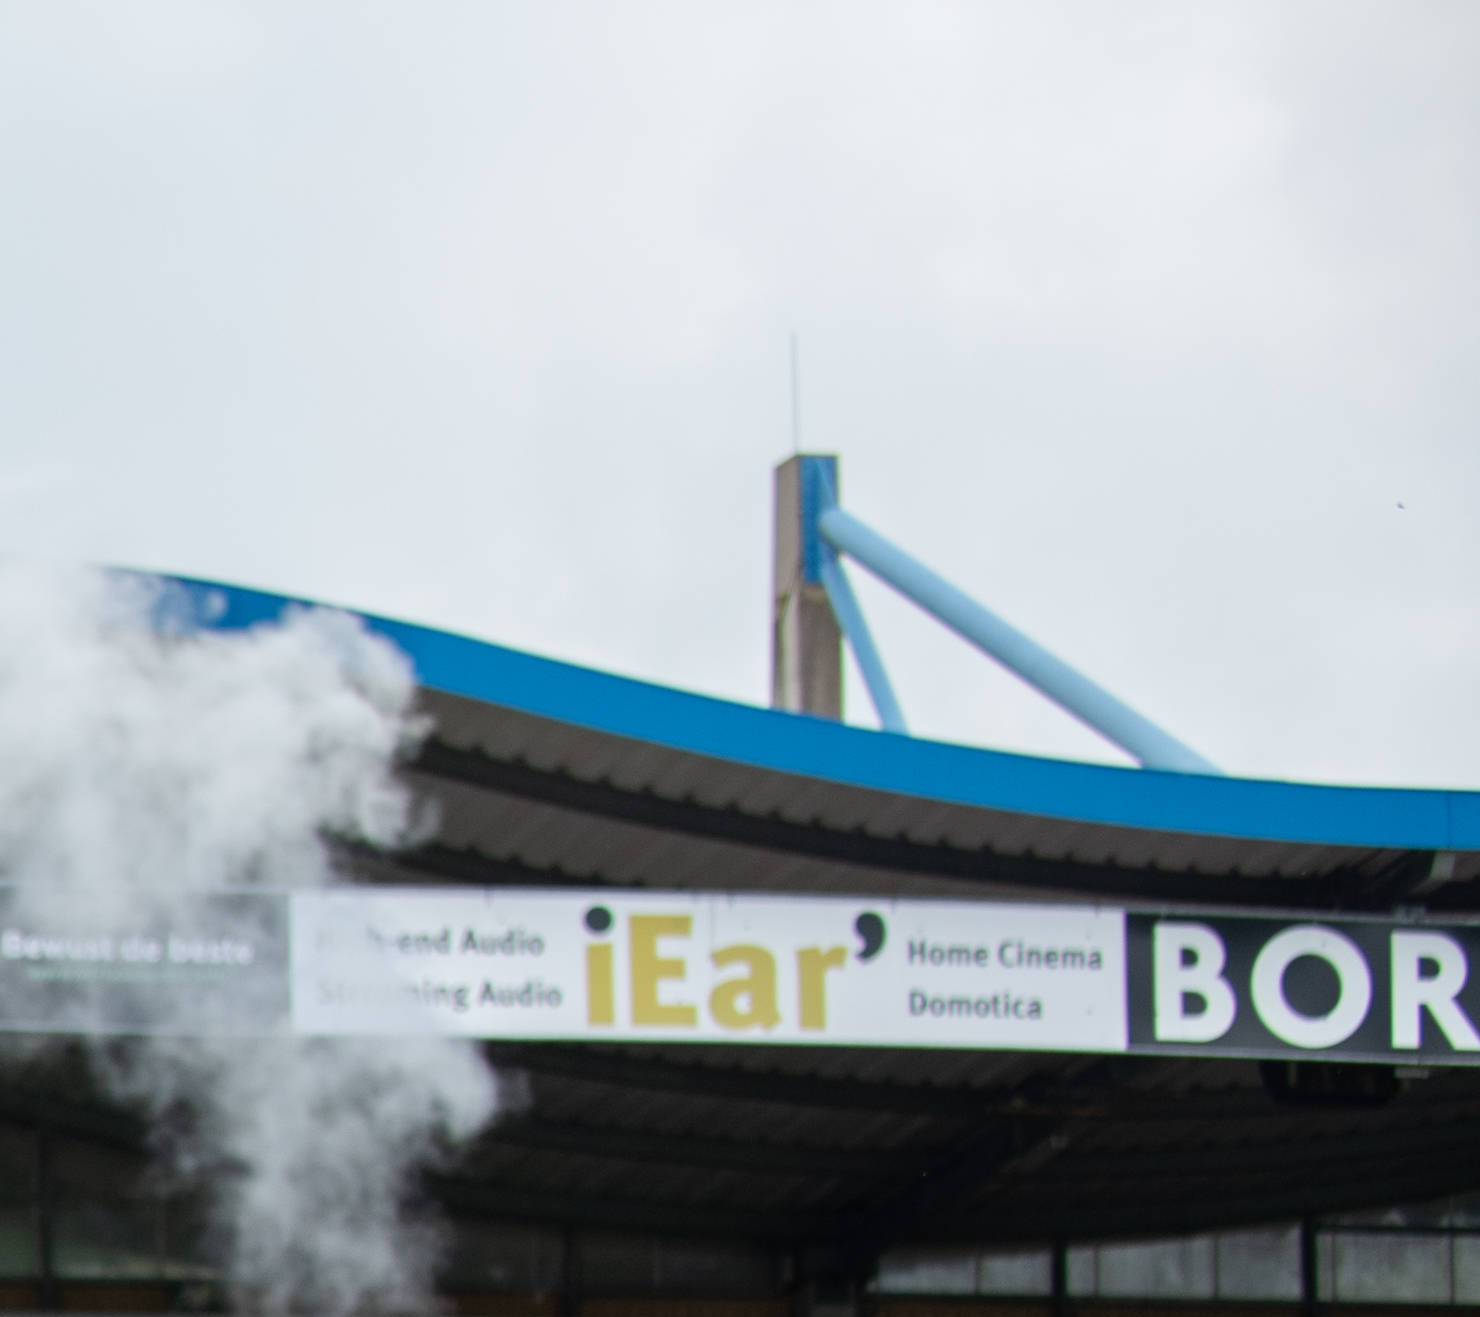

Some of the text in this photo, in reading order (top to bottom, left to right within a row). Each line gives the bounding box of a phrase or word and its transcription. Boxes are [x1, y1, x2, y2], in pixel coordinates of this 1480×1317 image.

[461, 927, 547, 957] Audio
[908, 940, 1104, 971] Home Cinema
[478, 980, 564, 1009] Audio
[1152, 921, 1480, 1053] BOR
[909, 989, 1044, 1021] Domotica
